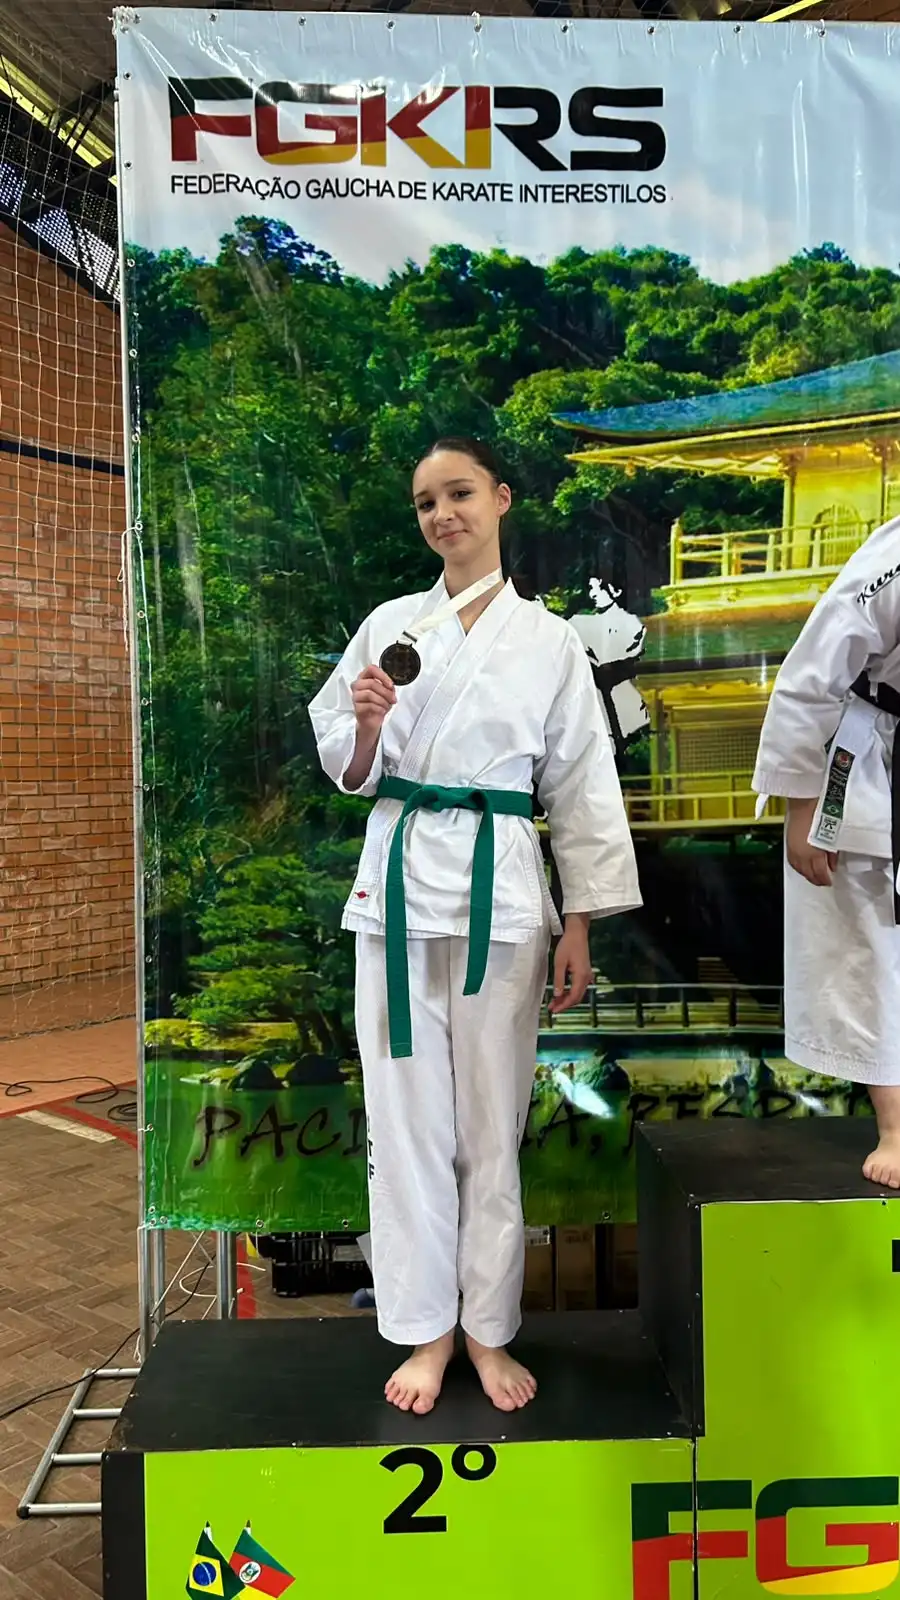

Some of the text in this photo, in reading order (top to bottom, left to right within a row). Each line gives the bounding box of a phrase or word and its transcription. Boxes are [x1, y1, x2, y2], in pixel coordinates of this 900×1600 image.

[168, 75, 667, 172] FGKIRS
[171, 173, 667, 204] FEDERAÇÃO GAUCHA DE KARATE INTERESTILOS
